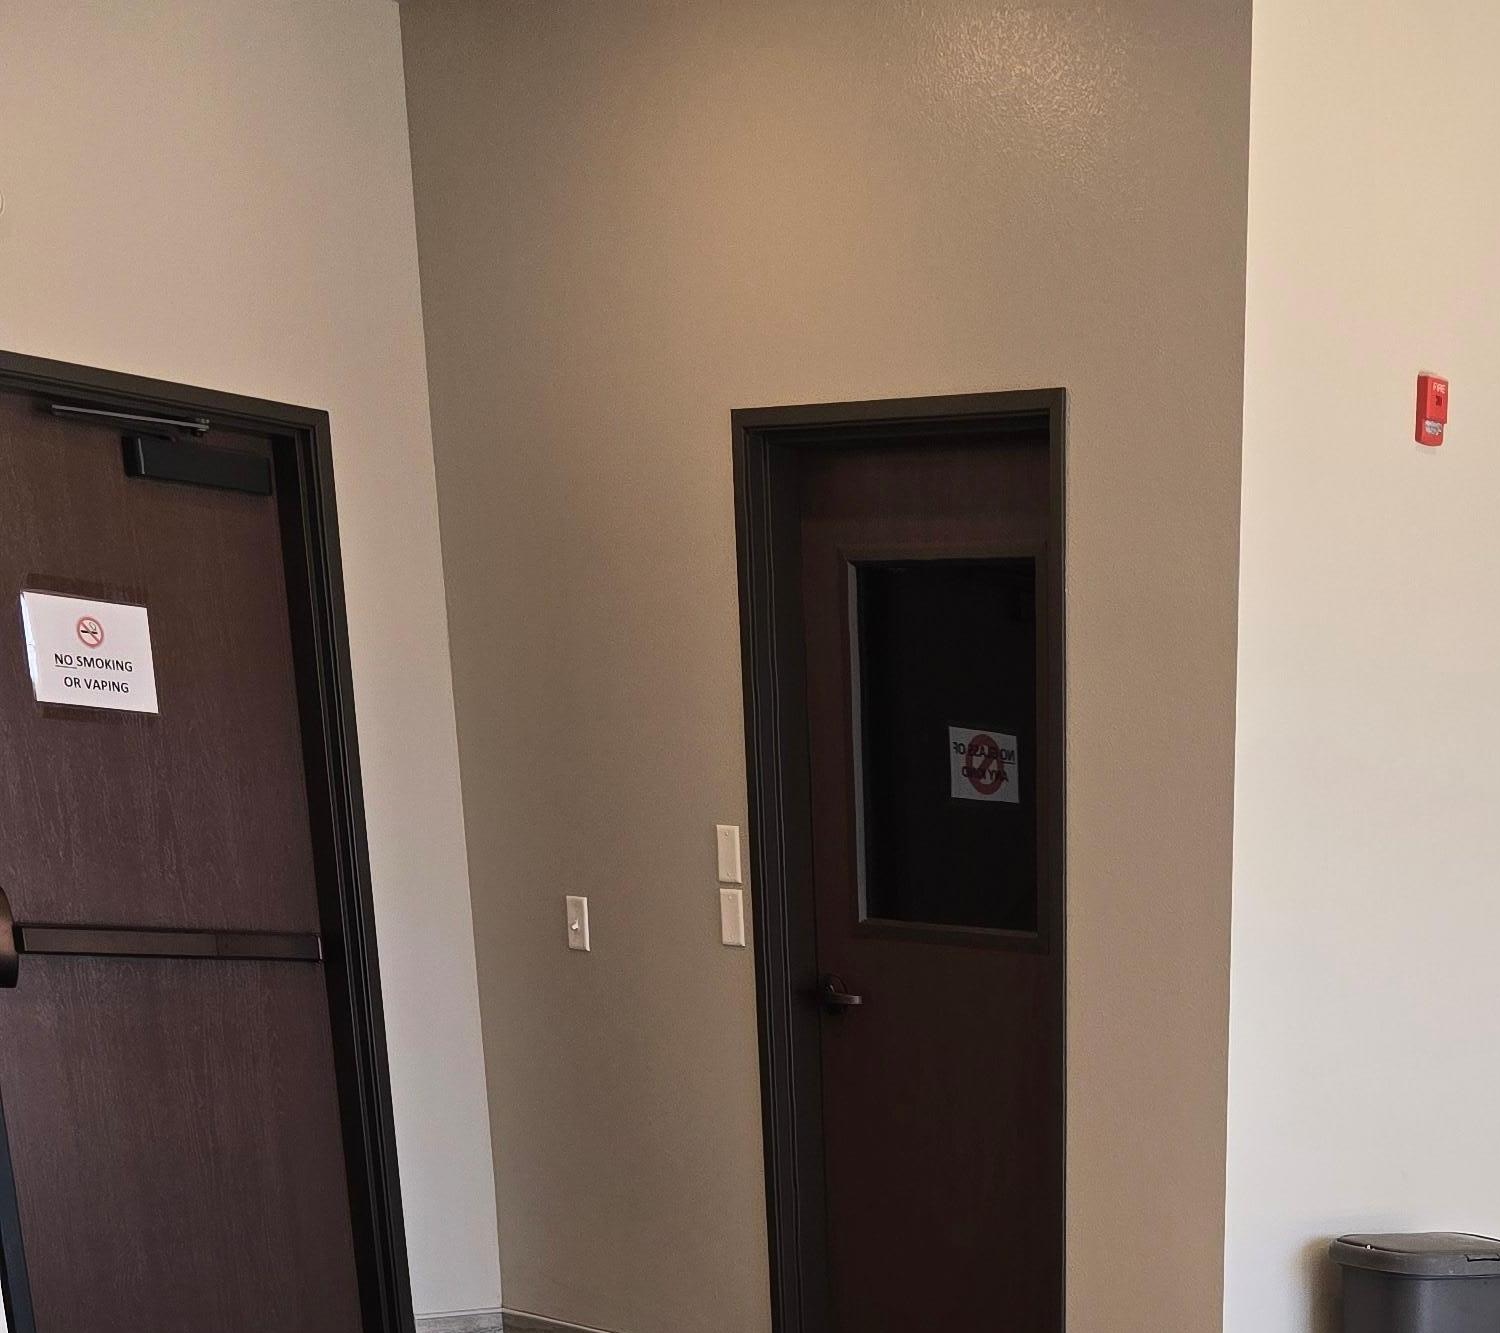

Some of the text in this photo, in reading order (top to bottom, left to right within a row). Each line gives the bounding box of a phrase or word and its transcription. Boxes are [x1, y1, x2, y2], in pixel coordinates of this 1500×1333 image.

[54, 653, 133, 672] NO SMOKING
[64, 677, 129, 693] OR VAPING
